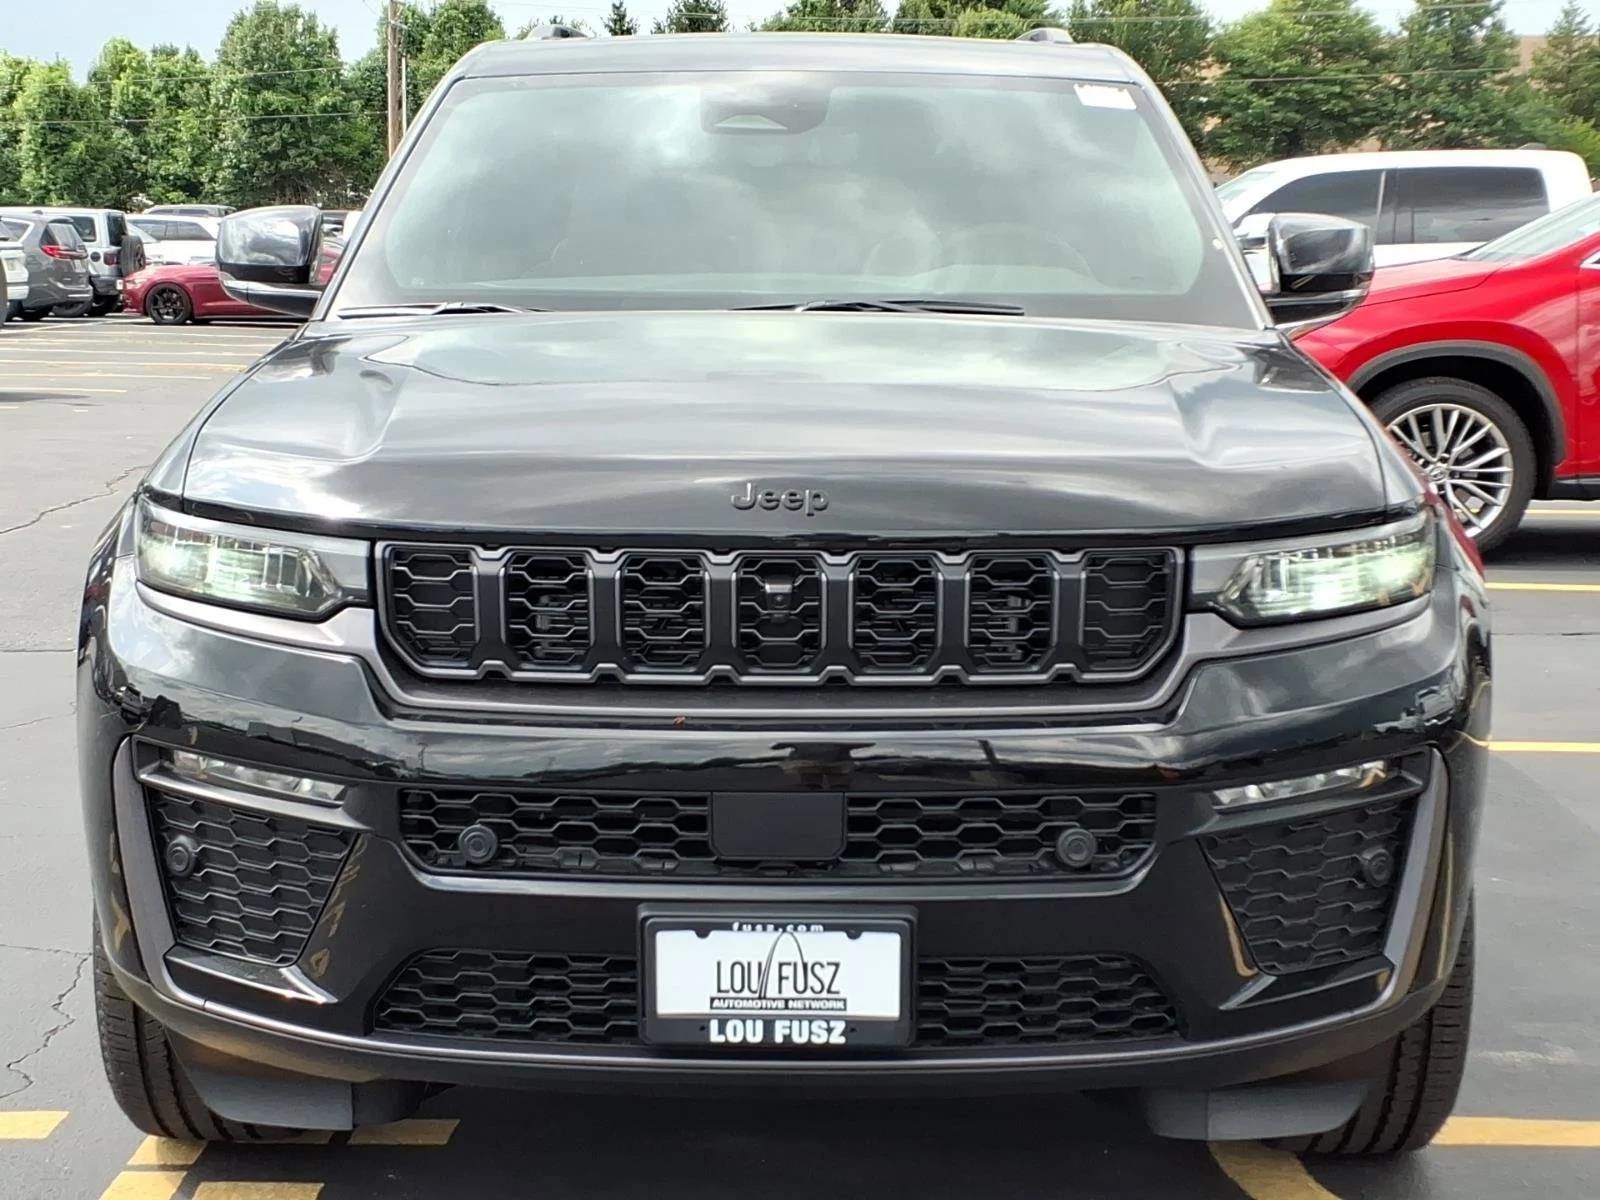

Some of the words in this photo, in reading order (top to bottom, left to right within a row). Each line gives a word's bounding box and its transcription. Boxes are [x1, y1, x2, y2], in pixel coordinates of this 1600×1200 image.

[731, 482, 829, 517] Jeep
[716, 961, 762, 994] LOU
[778, 961, 840, 995] FUSZ
[712, 999, 785, 1009] AUTOMOTIVE
[788, 1000, 845, 1010] NETWORK
[709, 1019, 763, 1043] LOU
[775, 1019, 846, 1044] FUSZ
